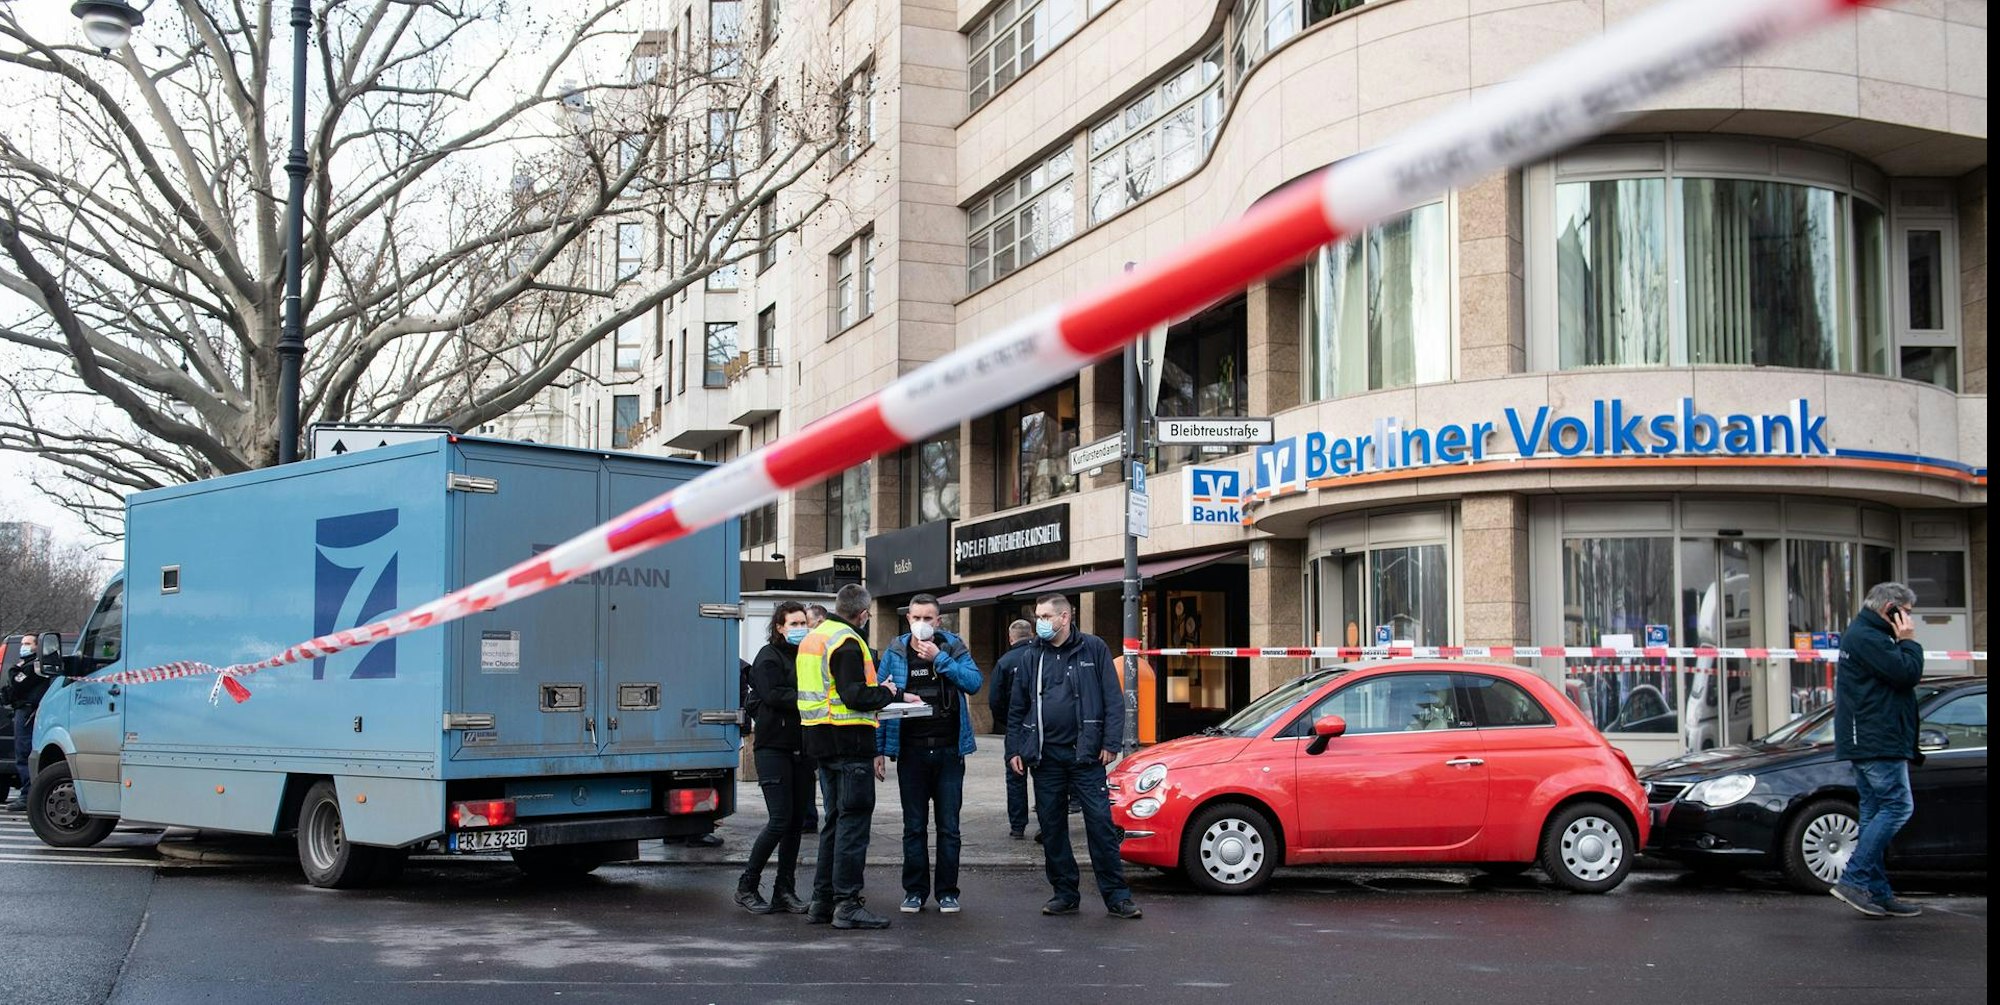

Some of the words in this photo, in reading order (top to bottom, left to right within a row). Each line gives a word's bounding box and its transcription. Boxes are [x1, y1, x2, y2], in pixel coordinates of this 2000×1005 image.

[1171, 424, 1259, 439] Bleibtreustraße
[1307, 416, 1493, 478] Berliner
[1504, 397, 1830, 457] Volksbank
[1073, 443, 1120, 466] Kurfürstendamm
[1192, 506, 1240, 522] Bank
[962, 538, 987, 558] DELFI
[1253, 548, 1265, 561] 46
[894, 559, 912, 574] ba&sh
[483, 833, 492, 847] Z
[494, 831, 526, 847] 3230
